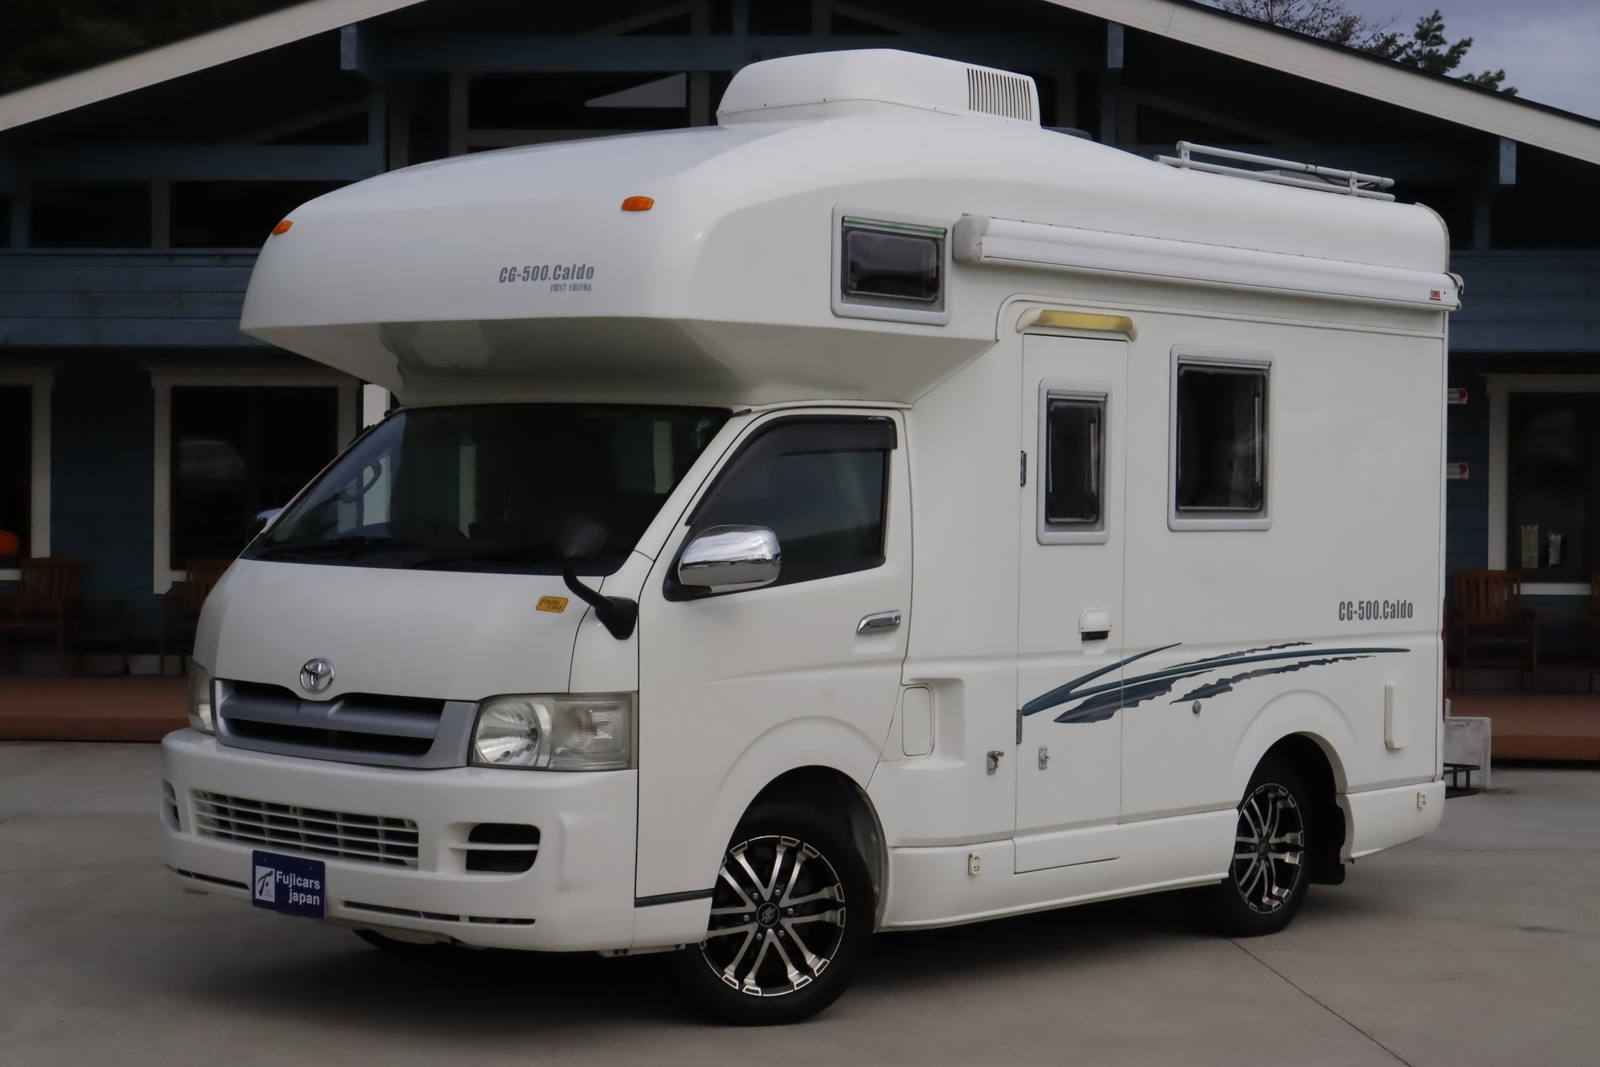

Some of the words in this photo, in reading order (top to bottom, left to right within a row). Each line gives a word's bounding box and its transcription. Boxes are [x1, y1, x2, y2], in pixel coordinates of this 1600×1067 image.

[499, 264, 595, 283] CG-500.Caldo
[1338, 599, 1413, 621] CG-500.Caldo
[276, 870, 321, 890] Fujicars
[288, 888, 320, 906] japan
